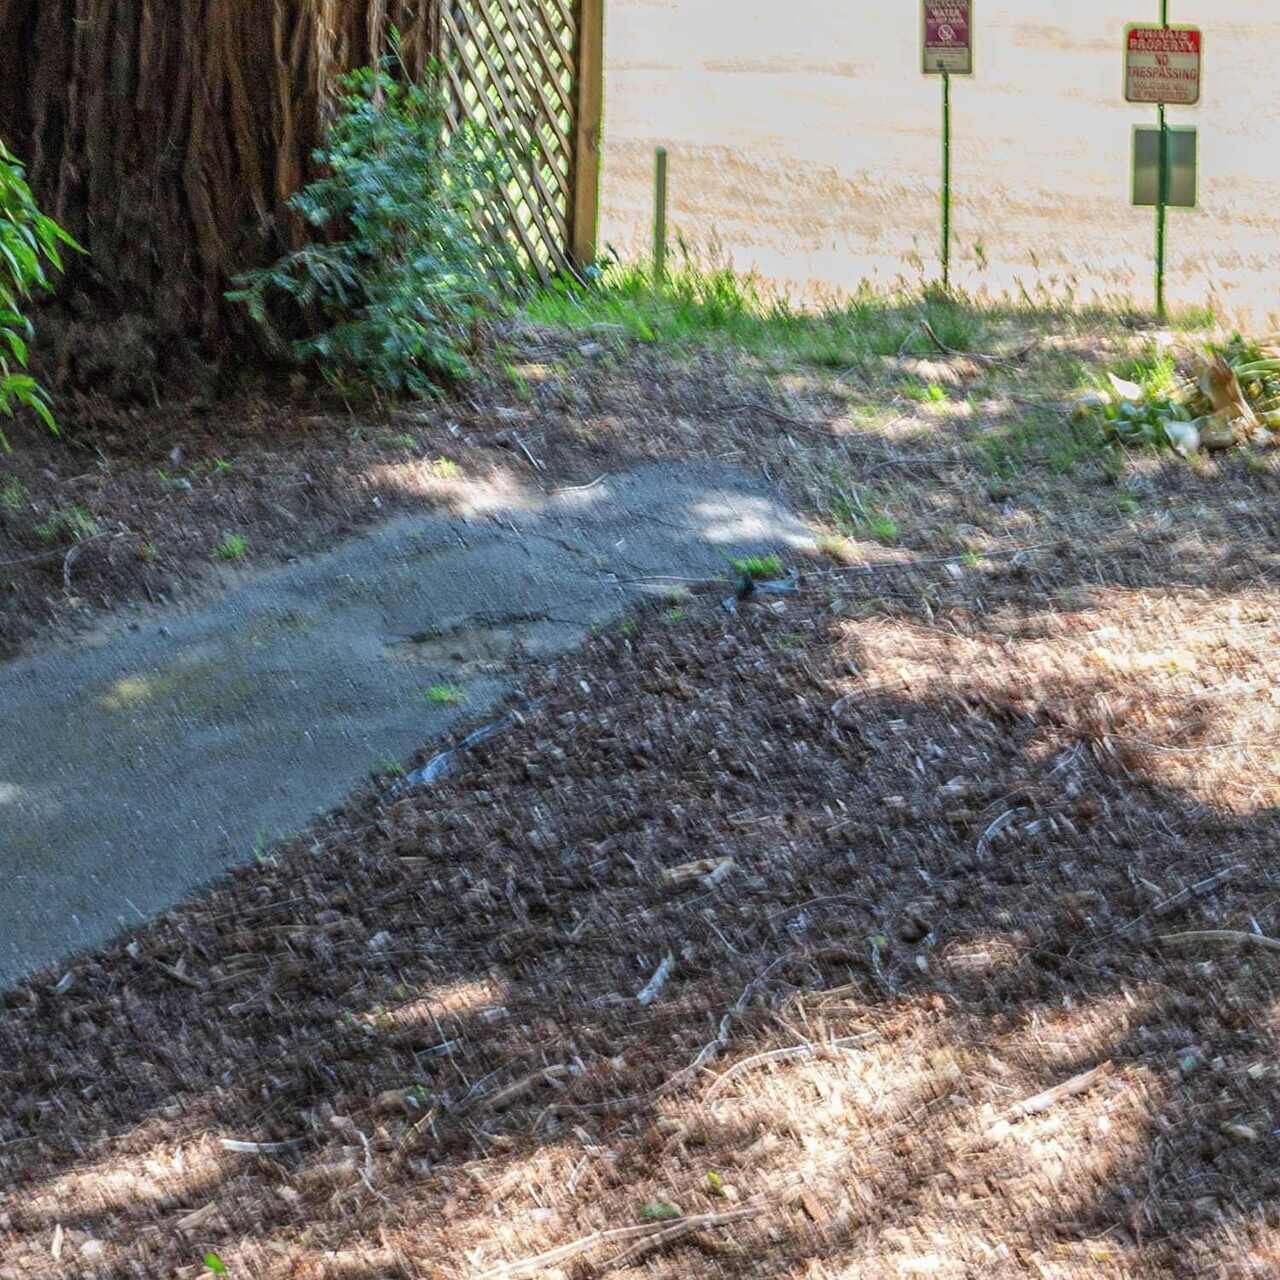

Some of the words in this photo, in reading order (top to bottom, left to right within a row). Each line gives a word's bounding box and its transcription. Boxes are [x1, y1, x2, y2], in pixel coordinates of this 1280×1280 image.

[1136, 29, 1188, 39] PRIVATE
[1130, 39, 1194, 50] PROPERTY
[1155, 54, 1168, 65] NO
[1127, 66, 1196, 79] TRESPASSING
